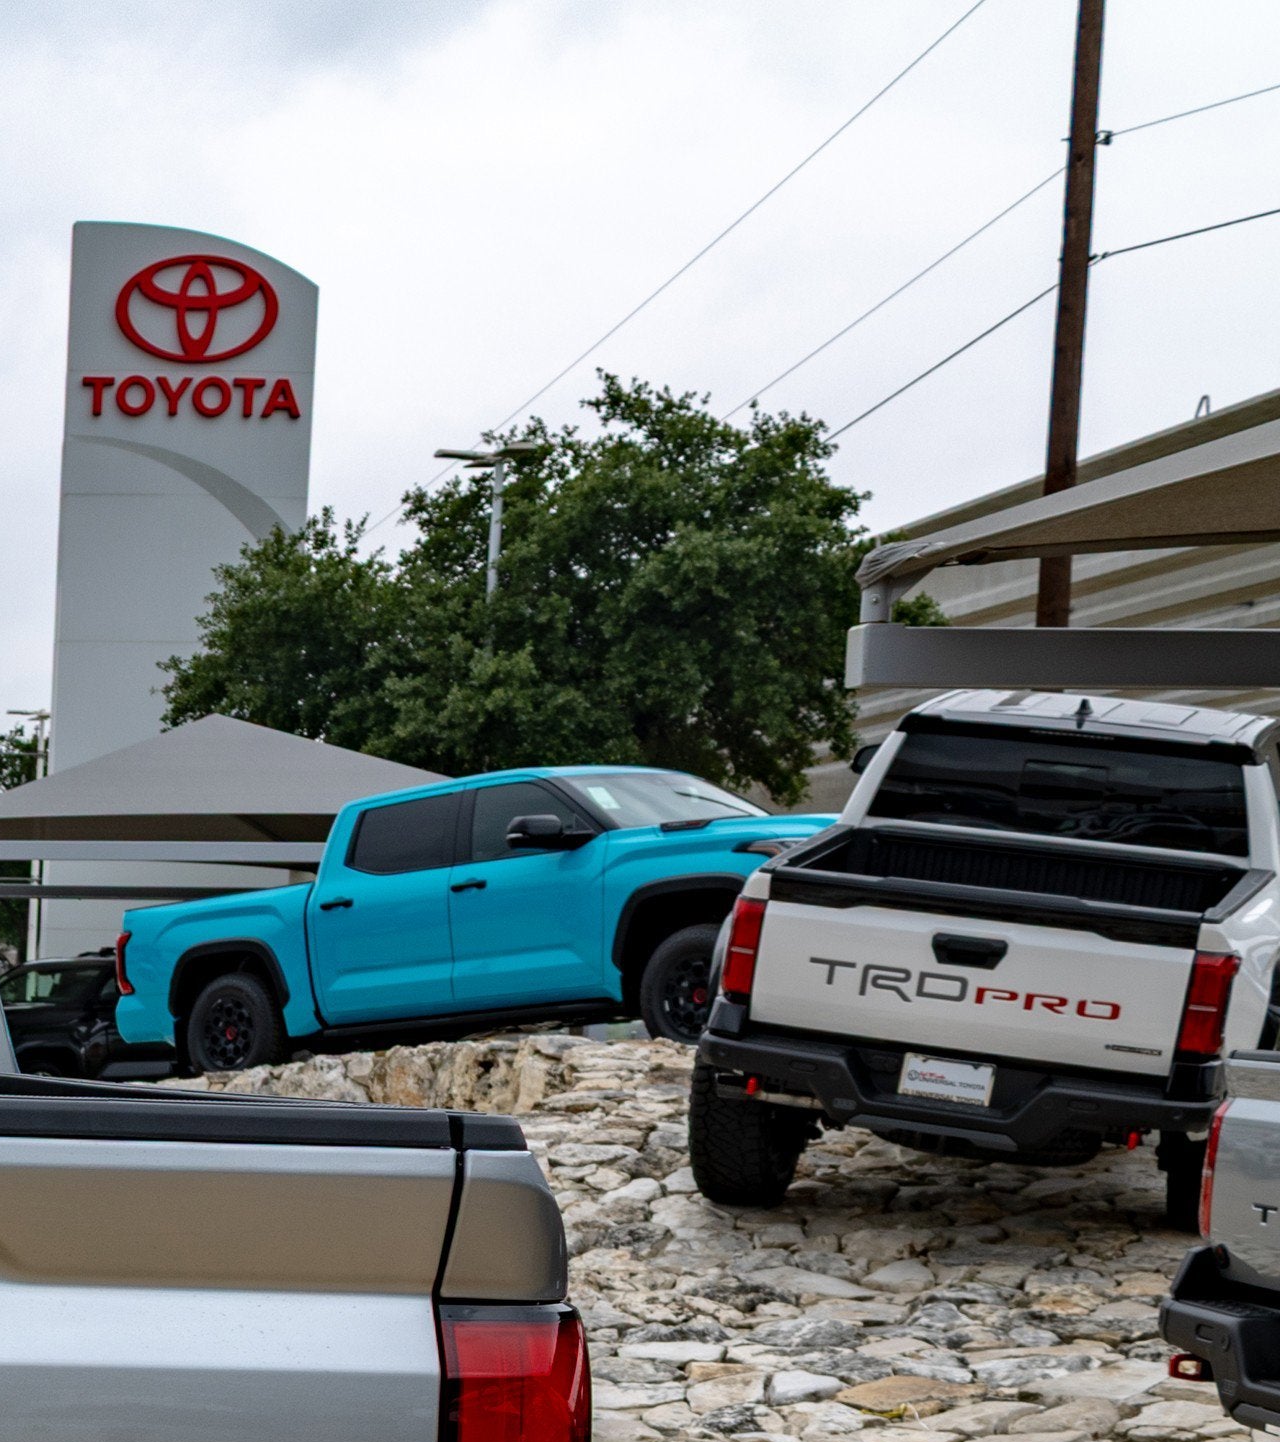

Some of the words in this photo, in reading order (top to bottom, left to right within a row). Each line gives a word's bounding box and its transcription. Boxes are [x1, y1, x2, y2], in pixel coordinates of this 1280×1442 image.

[82, 375, 301, 419] TOYOTA
[809, 957, 969, 1002] TRD
[974, 986, 1121, 1020] PRO
